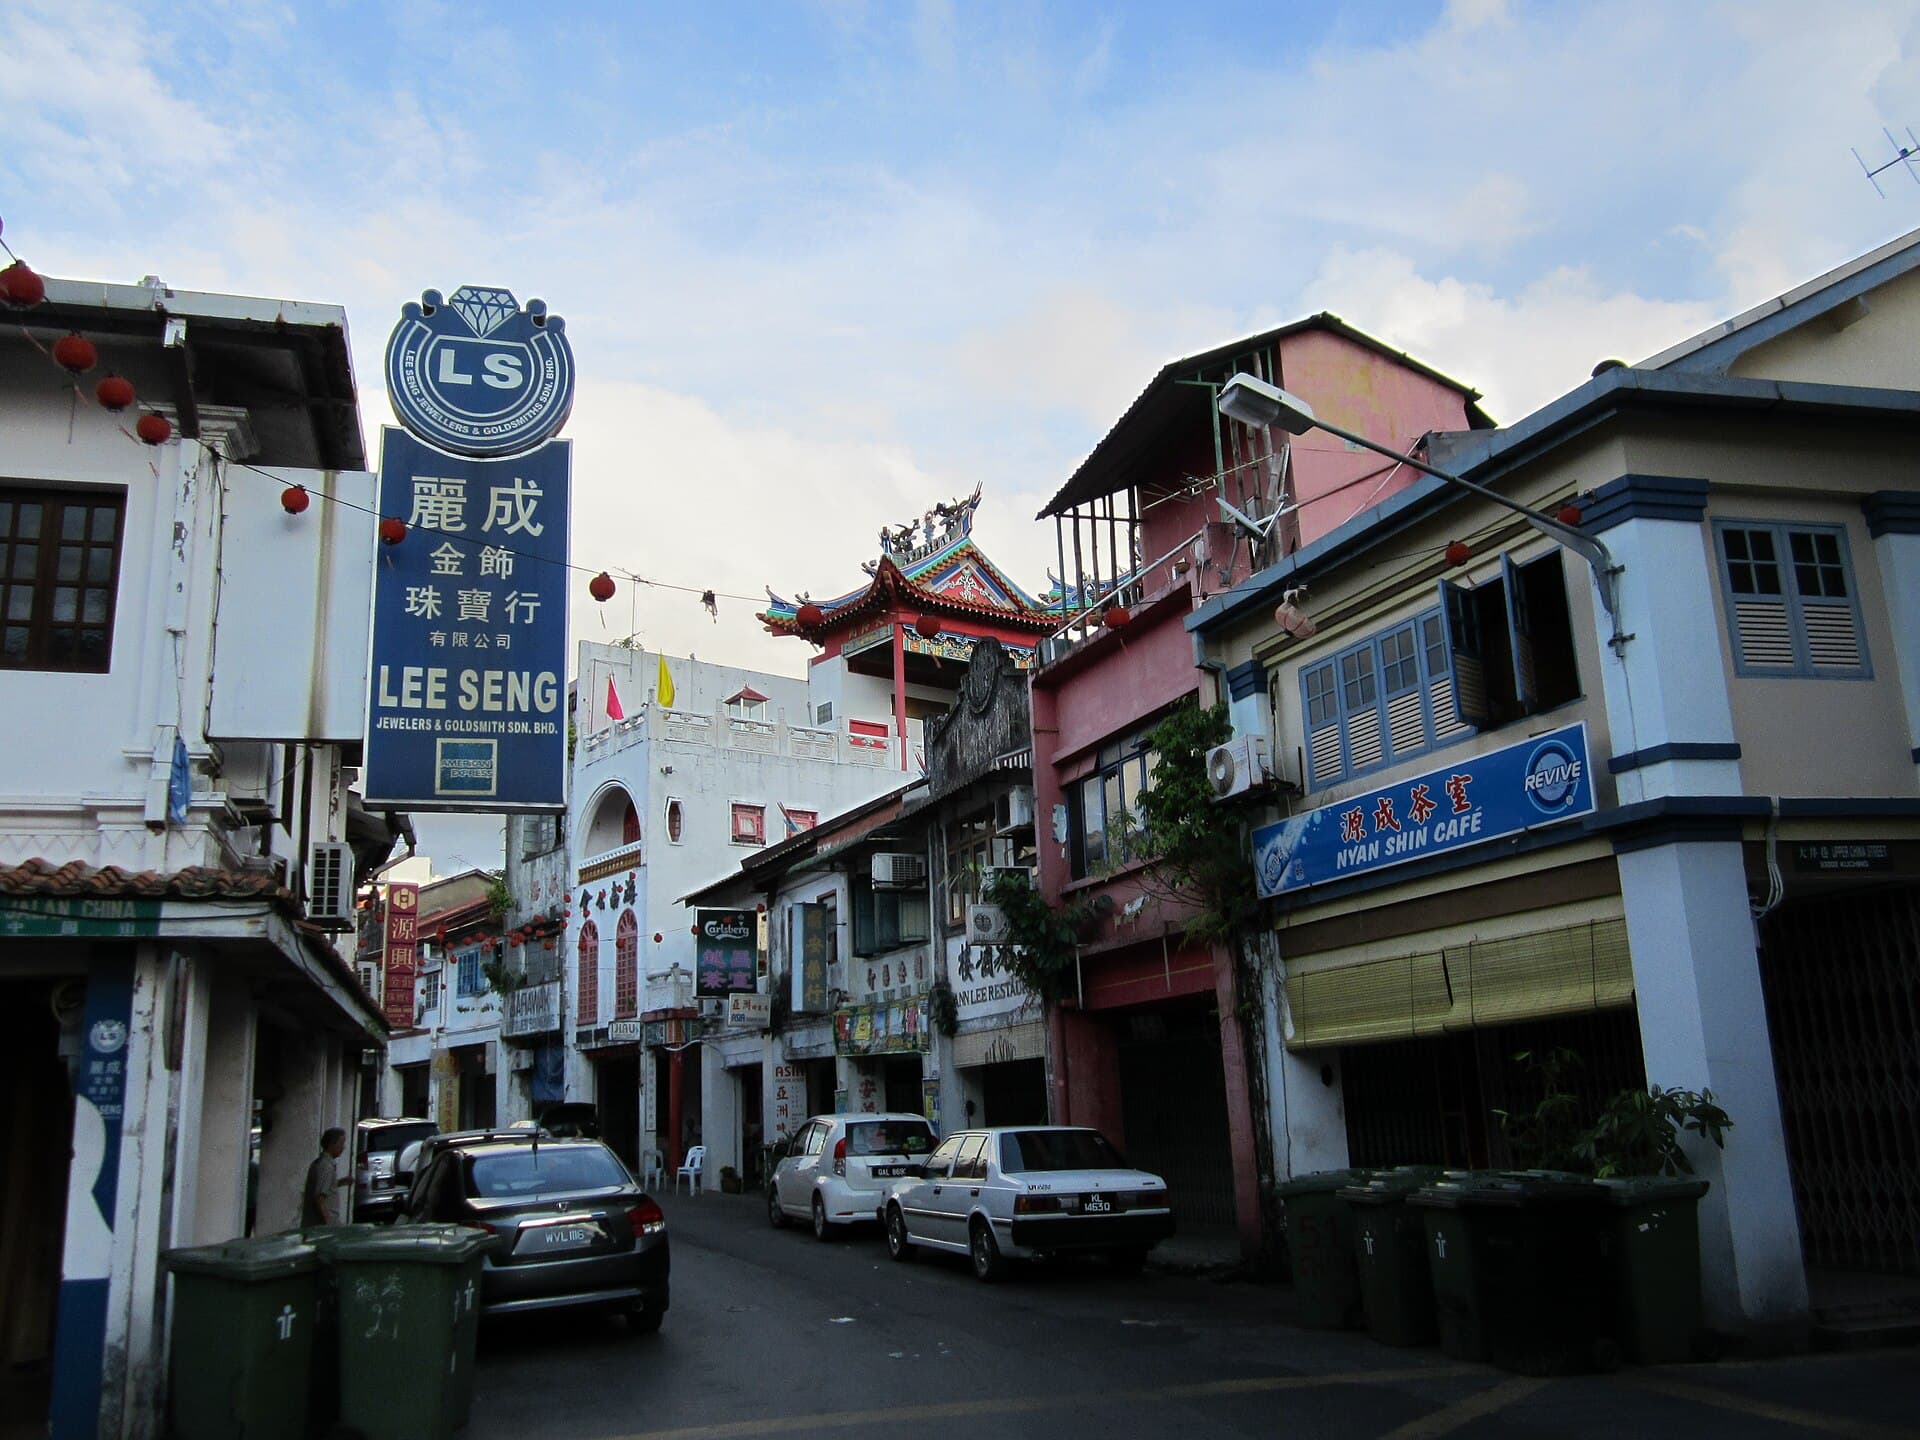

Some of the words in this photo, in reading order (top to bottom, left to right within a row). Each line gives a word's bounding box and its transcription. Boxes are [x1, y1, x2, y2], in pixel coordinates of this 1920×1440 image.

[404, 349, 416, 369] LEE
[546, 357, 554, 381] BHD.
[405, 369, 420, 396] SENG
[541, 381, 554, 404] SDN.
[416, 393, 469, 434] JEWELLERS
[483, 403, 543, 435] GOLDSMITHS
[472, 427, 480, 435] &
[406, 475, 545, 537] 麗成
[429, 541, 515, 580] 金飾
[404, 585, 541, 625] 珠寶行
[429, 630, 512, 650] 有限公司
[378, 664, 448, 709] LEE
[458, 668, 558, 714] SENG
[376, 717, 433, 731] JEWELERS
[434, 718, 442, 731] &
[444, 718, 506, 733] GOLDSMITH
[507, 721, 532, 734] SDN.
[533, 722, 559, 735] BHD.
[1524, 760, 1582, 793] REVIVE
[1339, 773, 1473, 845] 源成茶室
[1336, 840, 1380, 870] NYAN
[1384, 825, 1428, 856] SHIN
[1433, 806, 1482, 843] CAFÉ
[81, 900, 136, 918] CHINA
[704, 920, 751, 937] Carlsberg
[390, 917, 415, 970] 源興
[970, 987, 987, 1005] LEE
